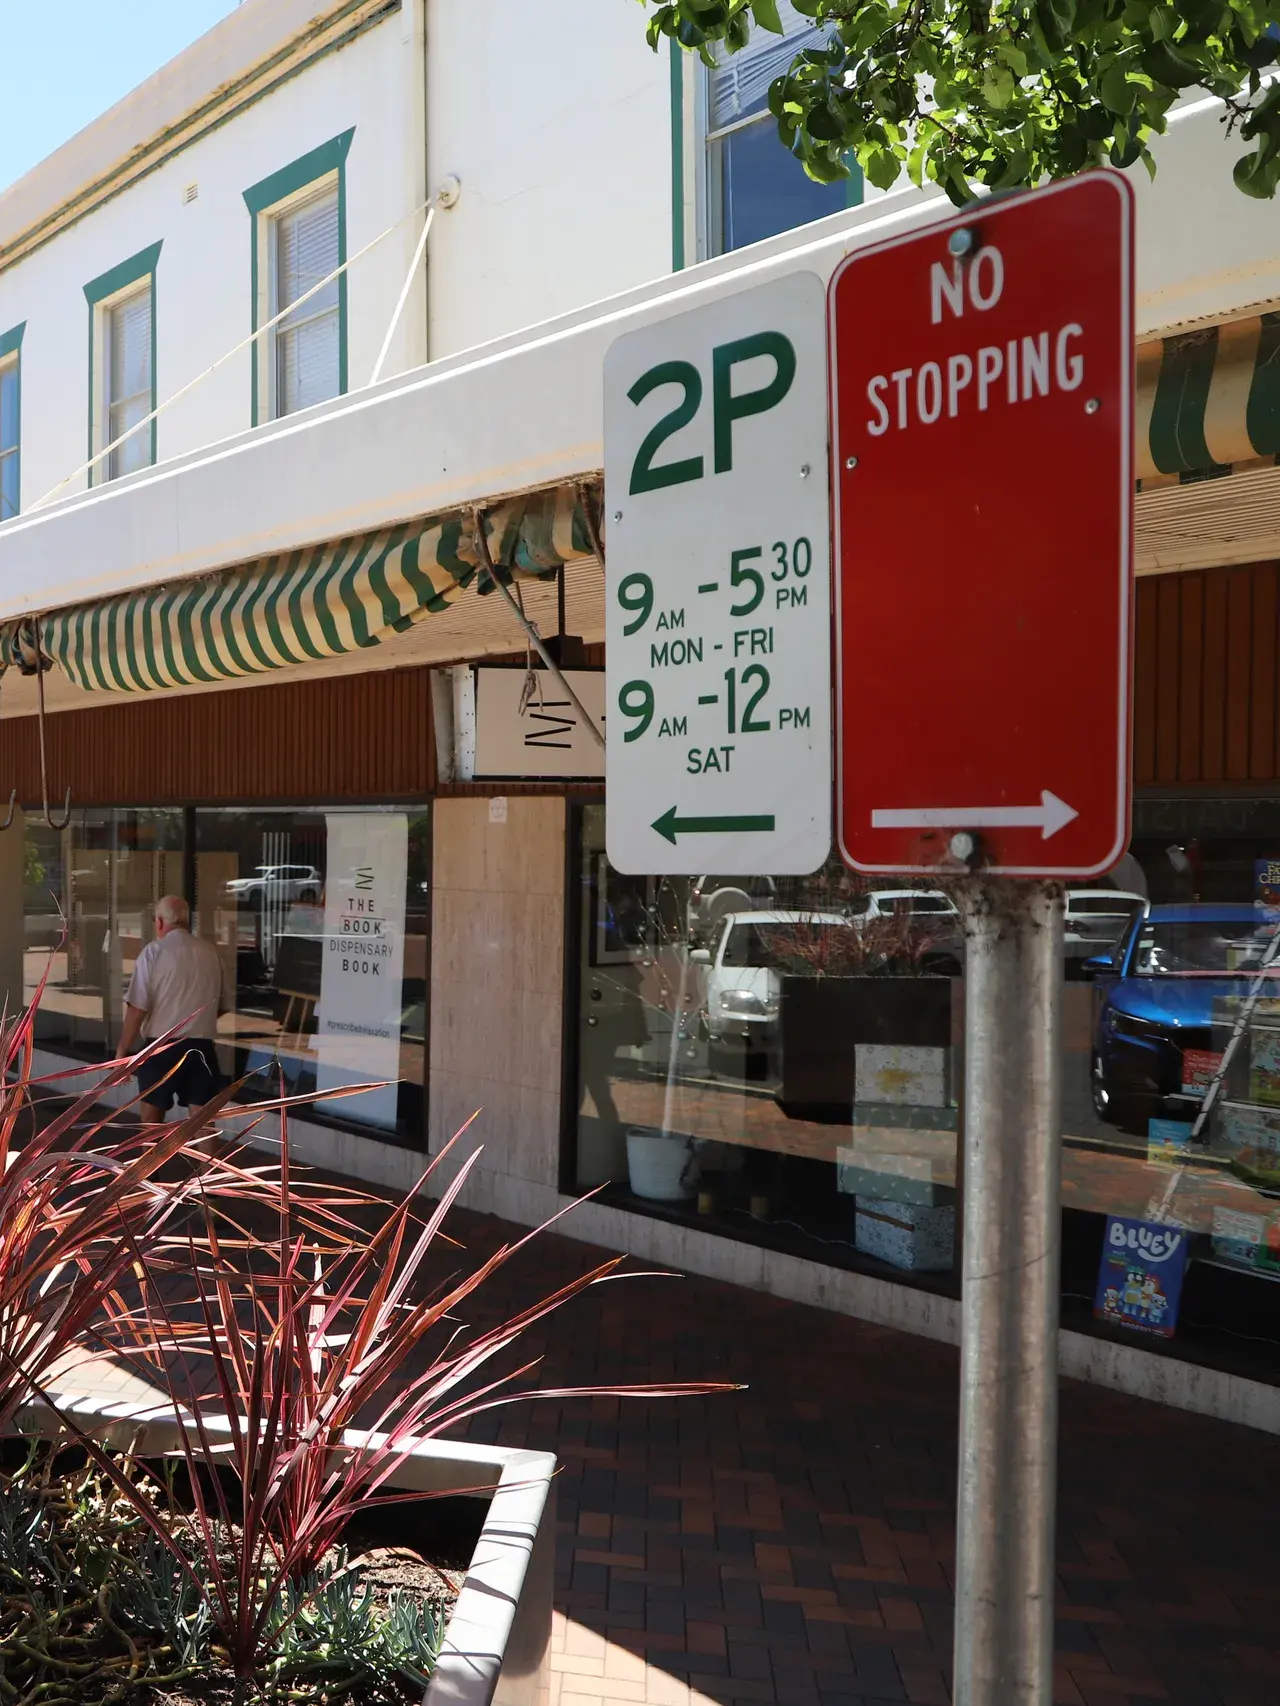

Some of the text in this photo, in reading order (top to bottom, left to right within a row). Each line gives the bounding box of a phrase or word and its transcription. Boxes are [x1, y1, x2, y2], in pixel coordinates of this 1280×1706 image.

[931, 246, 1004, 325] NO
[867, 323, 1084, 436] STOPPING
[627, 331, 797, 495] 2P
[618, 572, 654, 637] 9
[655, 608, 685, 632] AM
[776, 585, 808, 609] PM
[651, 637, 703, 668] MON
[734, 627, 774, 657] FRI
[618, 680, 654, 743] 9
[658, 716, 687, 737] AM
[779, 707, 811, 730] PM
[687, 746, 735, 774] SAT
[348, 898, 375, 912] THE
[343, 919, 381, 935] BOOK
[330, 940, 393, 958] DISPENSARY
[342, 959, 380, 976] BOOK
[1109, 1222, 1181, 1262] BLUEY
